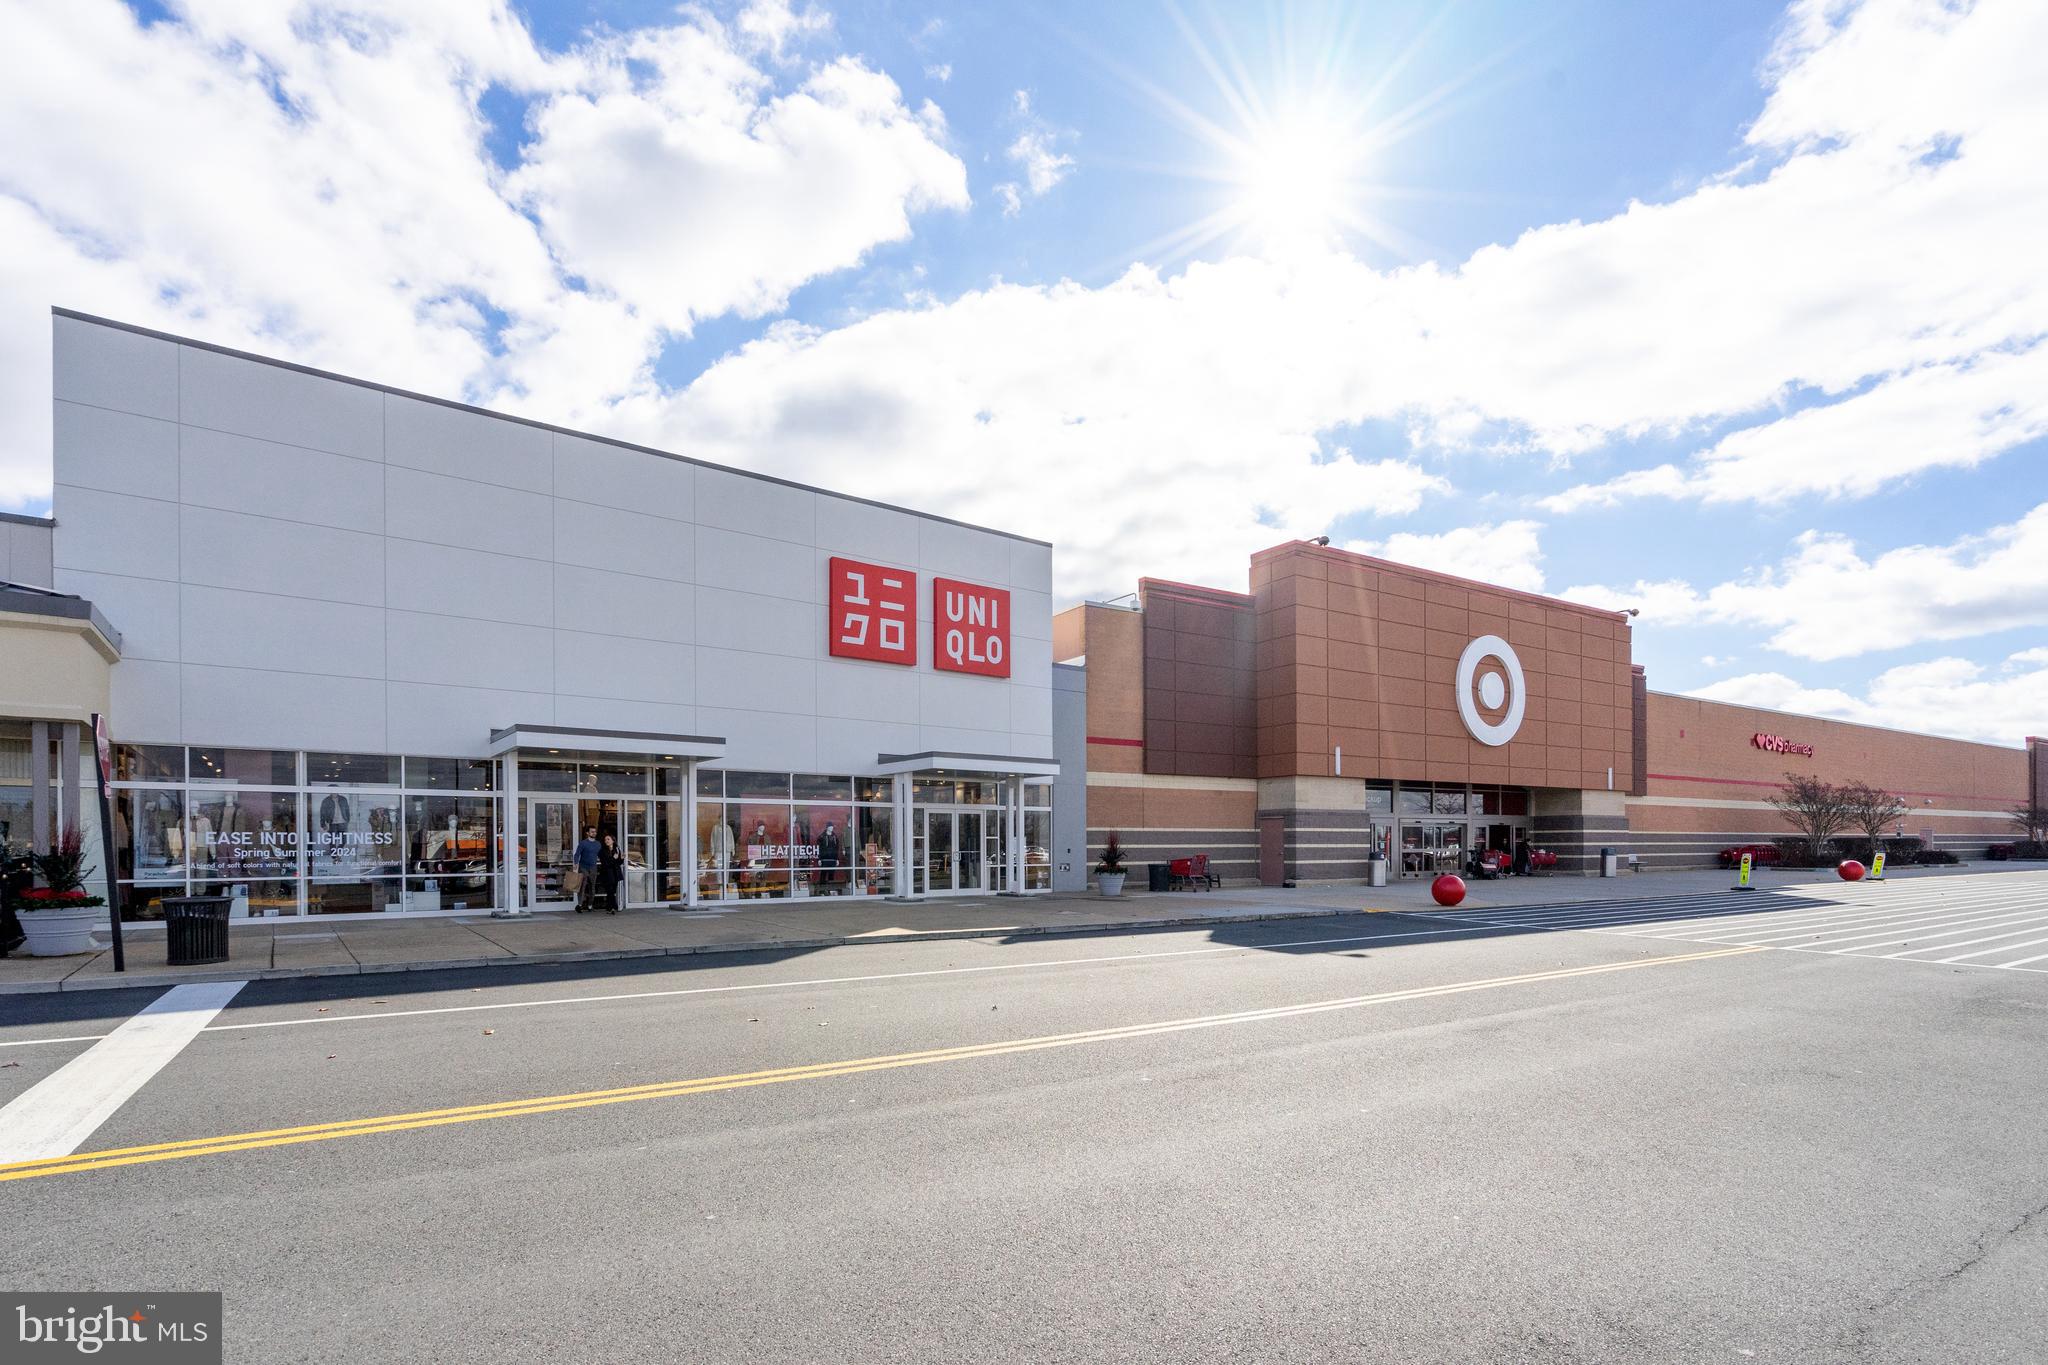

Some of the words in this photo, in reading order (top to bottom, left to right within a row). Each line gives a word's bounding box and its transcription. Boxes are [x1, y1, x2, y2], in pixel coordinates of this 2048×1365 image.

[946, 591, 998, 629] UNI
[946, 629, 1003, 666] QLO
[1765, 734, 1784, 752] CVS
[205, 831, 253, 845] EASE
[261, 831, 298, 845] INTO
[306, 831, 393, 845] LIGHTNESS
[233, 847, 270, 859] Spring
[330, 847, 356, 857] 2024
